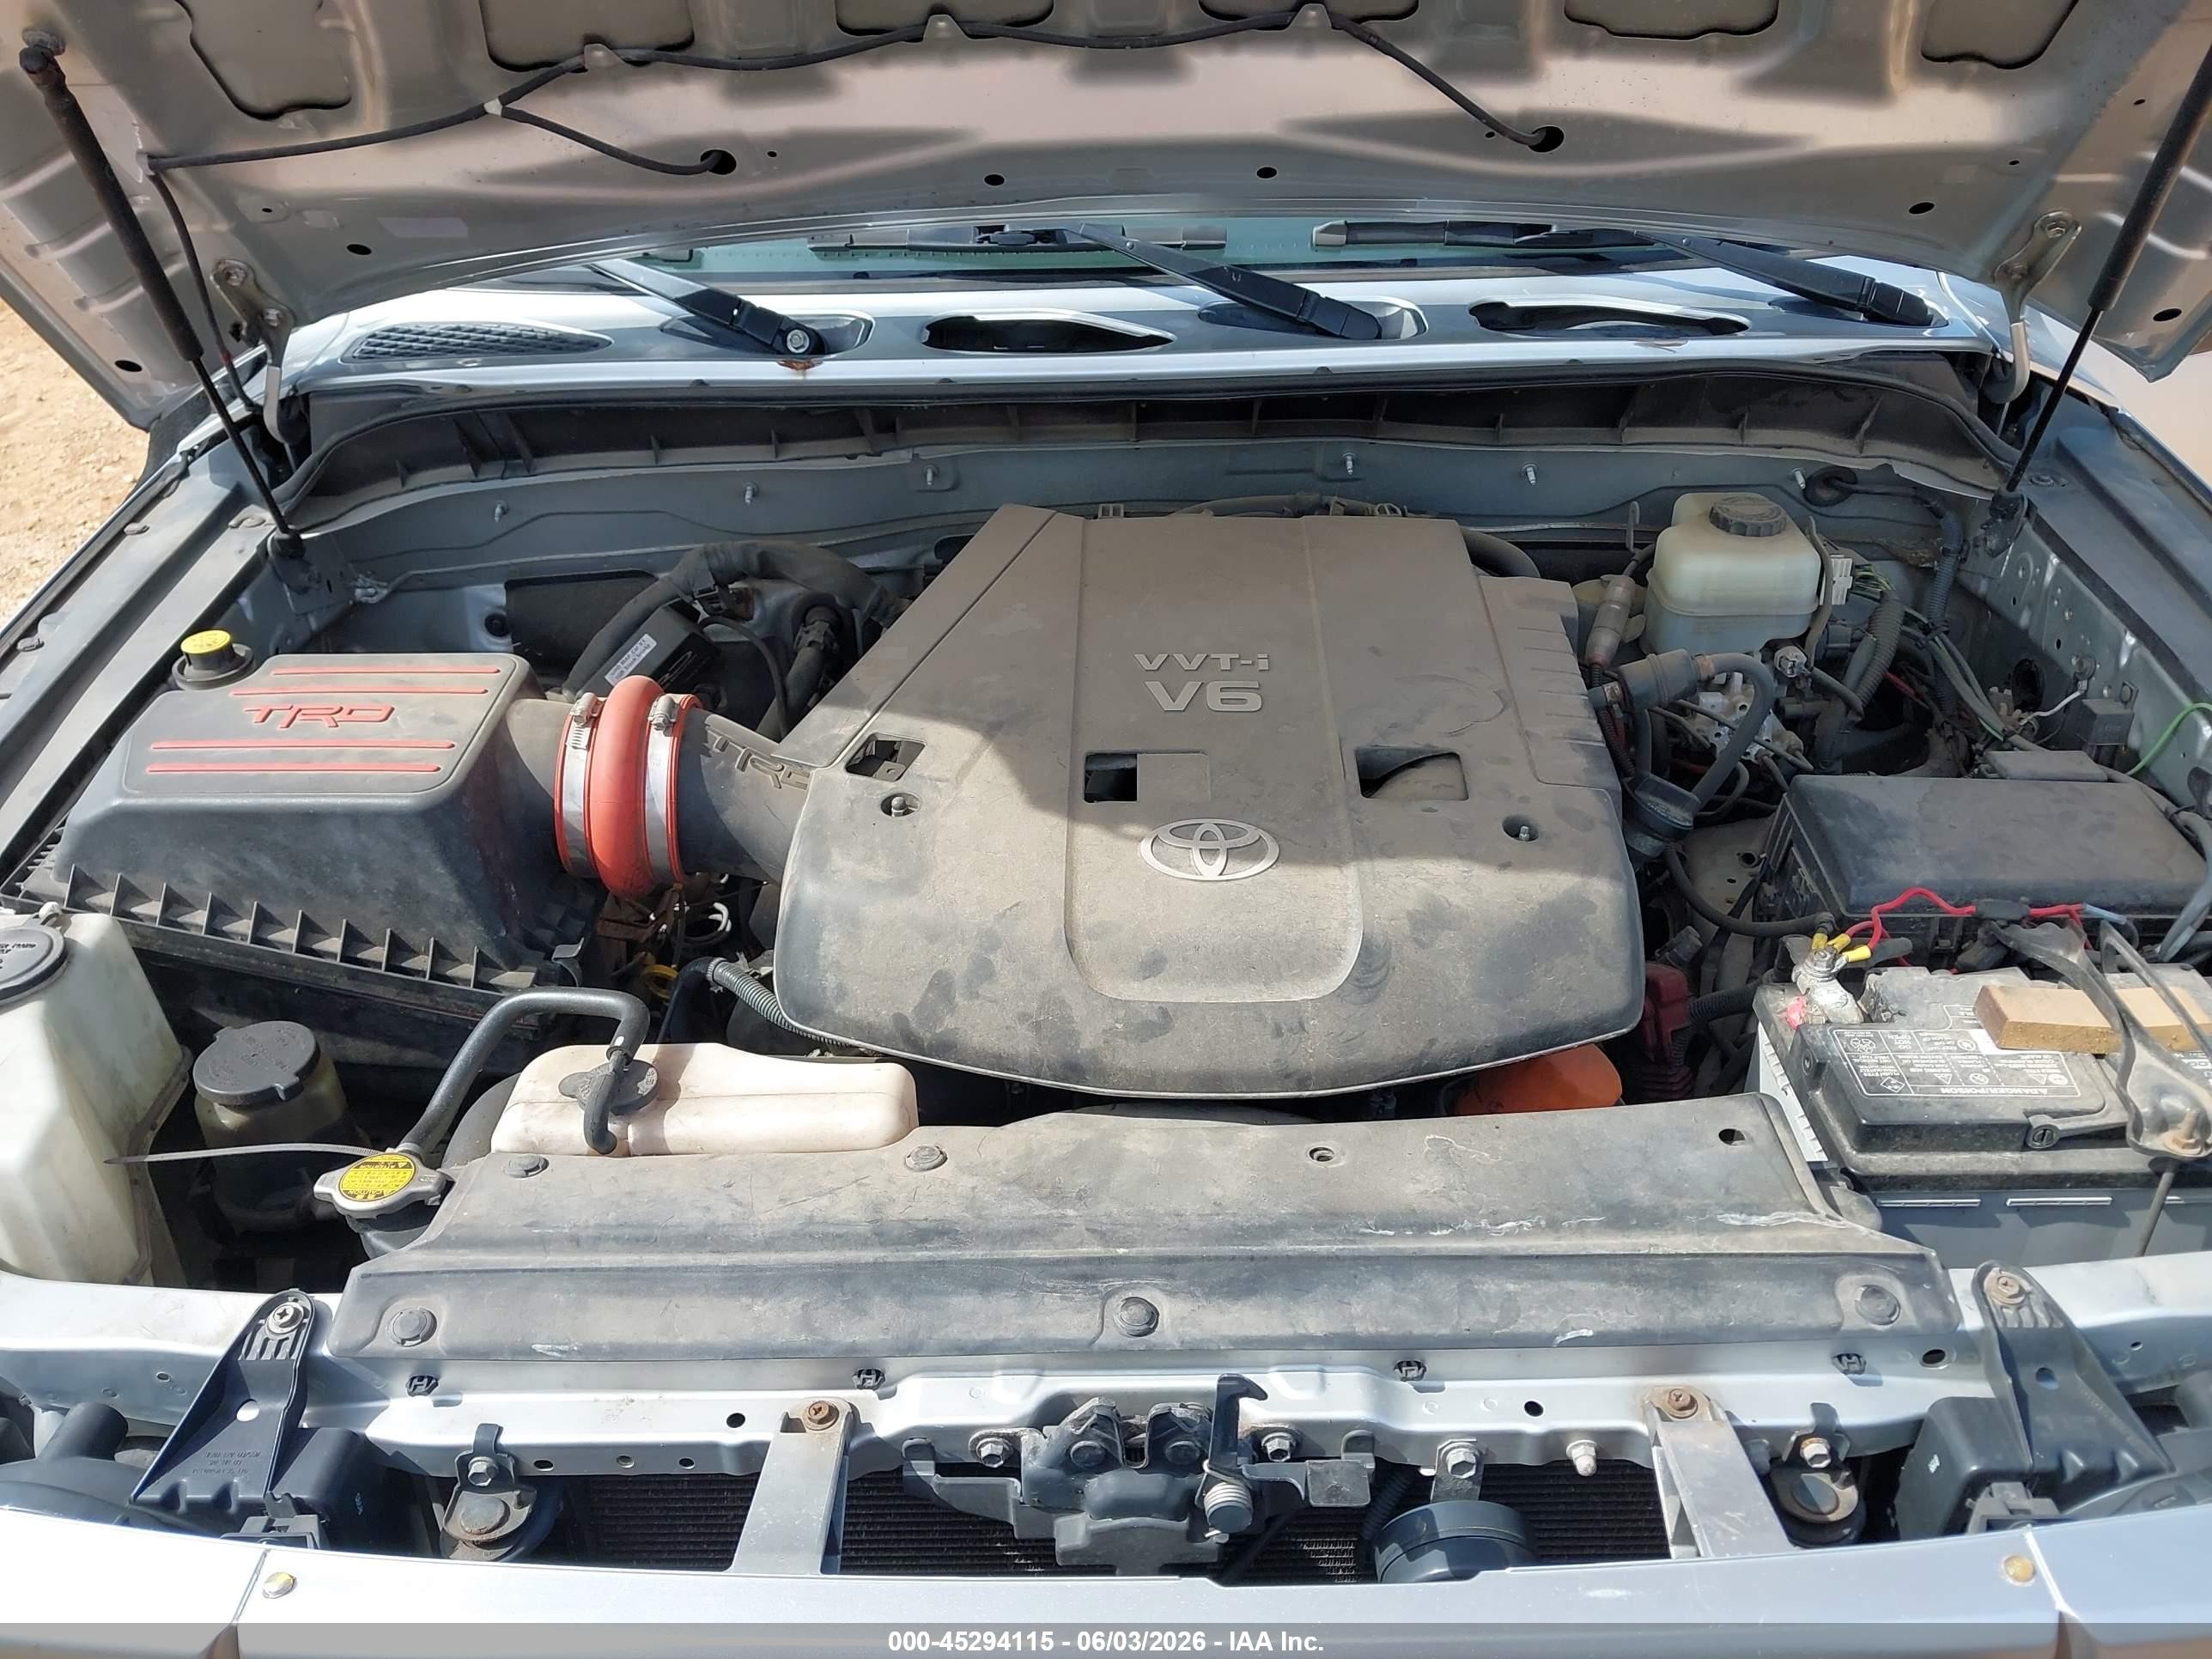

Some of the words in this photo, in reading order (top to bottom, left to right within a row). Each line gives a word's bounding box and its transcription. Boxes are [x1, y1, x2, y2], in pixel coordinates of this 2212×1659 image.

[1133, 653, 1270, 672] VVT-i
[1144, 680, 1263, 713] V6
[244, 703, 396, 730] TRD
